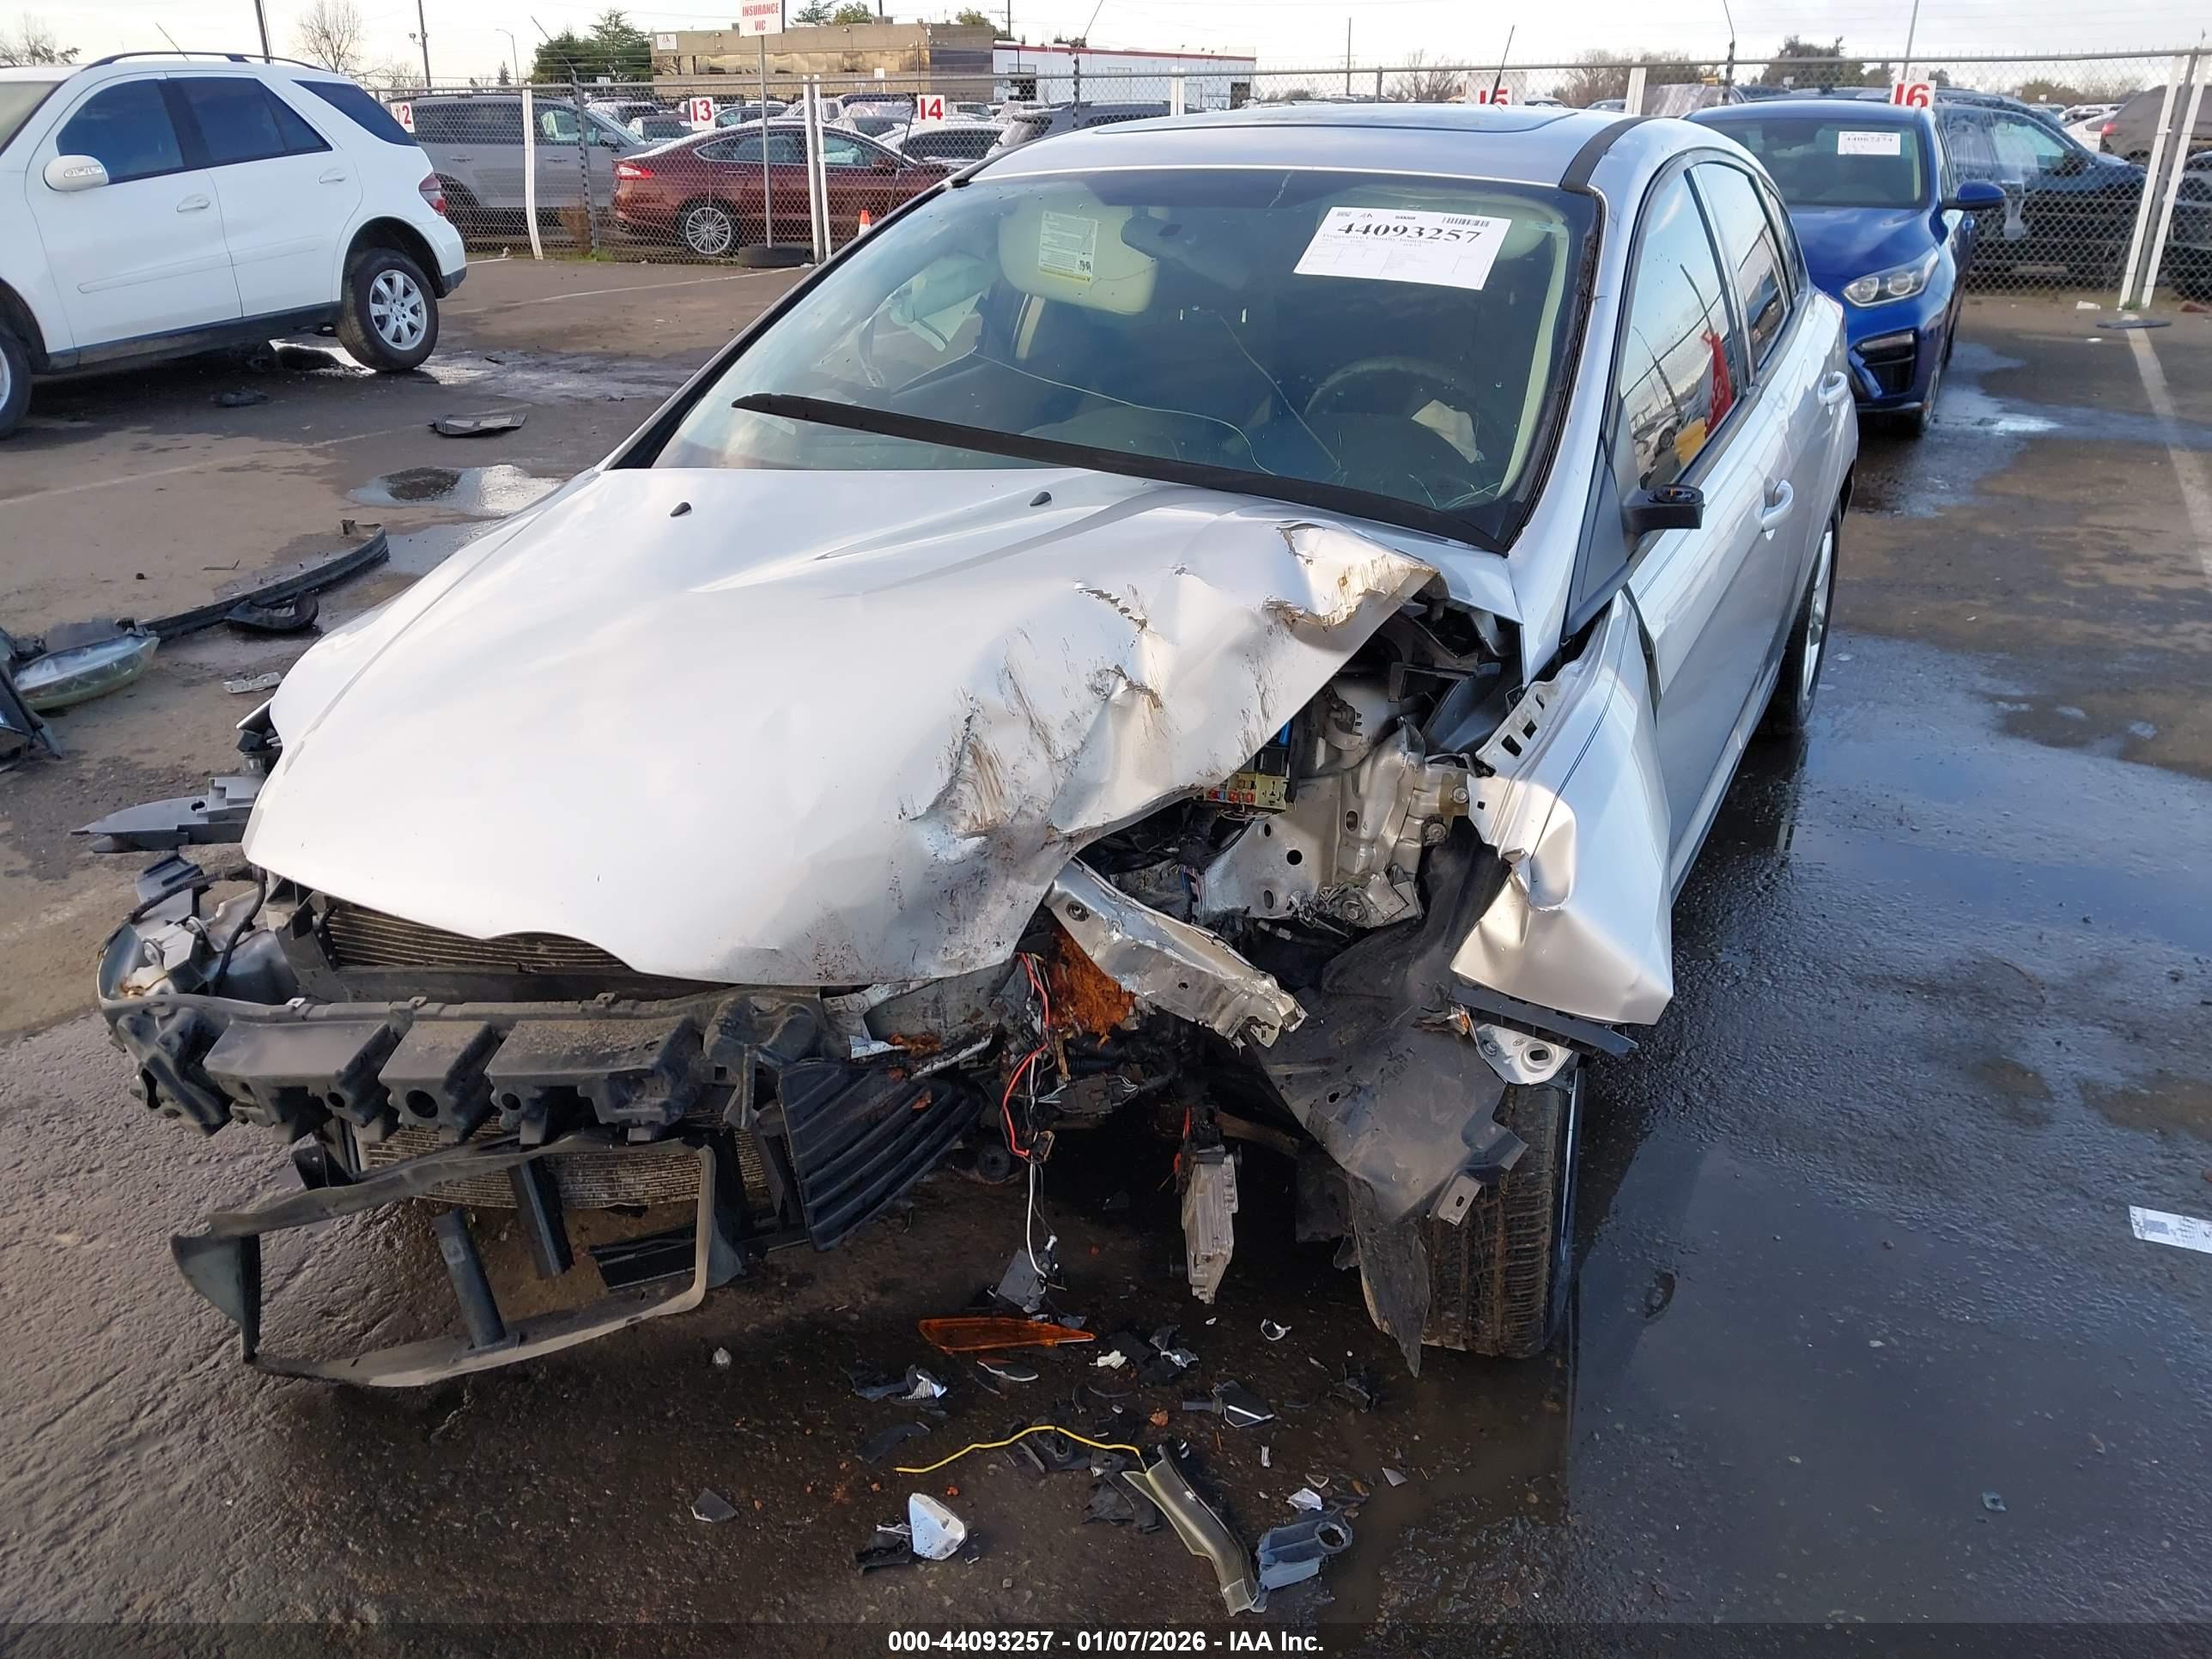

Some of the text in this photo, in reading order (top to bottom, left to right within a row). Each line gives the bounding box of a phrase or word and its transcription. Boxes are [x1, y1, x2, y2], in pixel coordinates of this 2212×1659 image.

[742, 3, 779, 16] INSURANCE
[754, 20, 766, 31] VIC
[1480, 89, 1508, 105] 15
[1894, 83, 1930, 108] 16
[691, 100, 712, 122] 13
[920, 98, 944, 120] 14
[1337, 222, 1483, 244] 44093257
